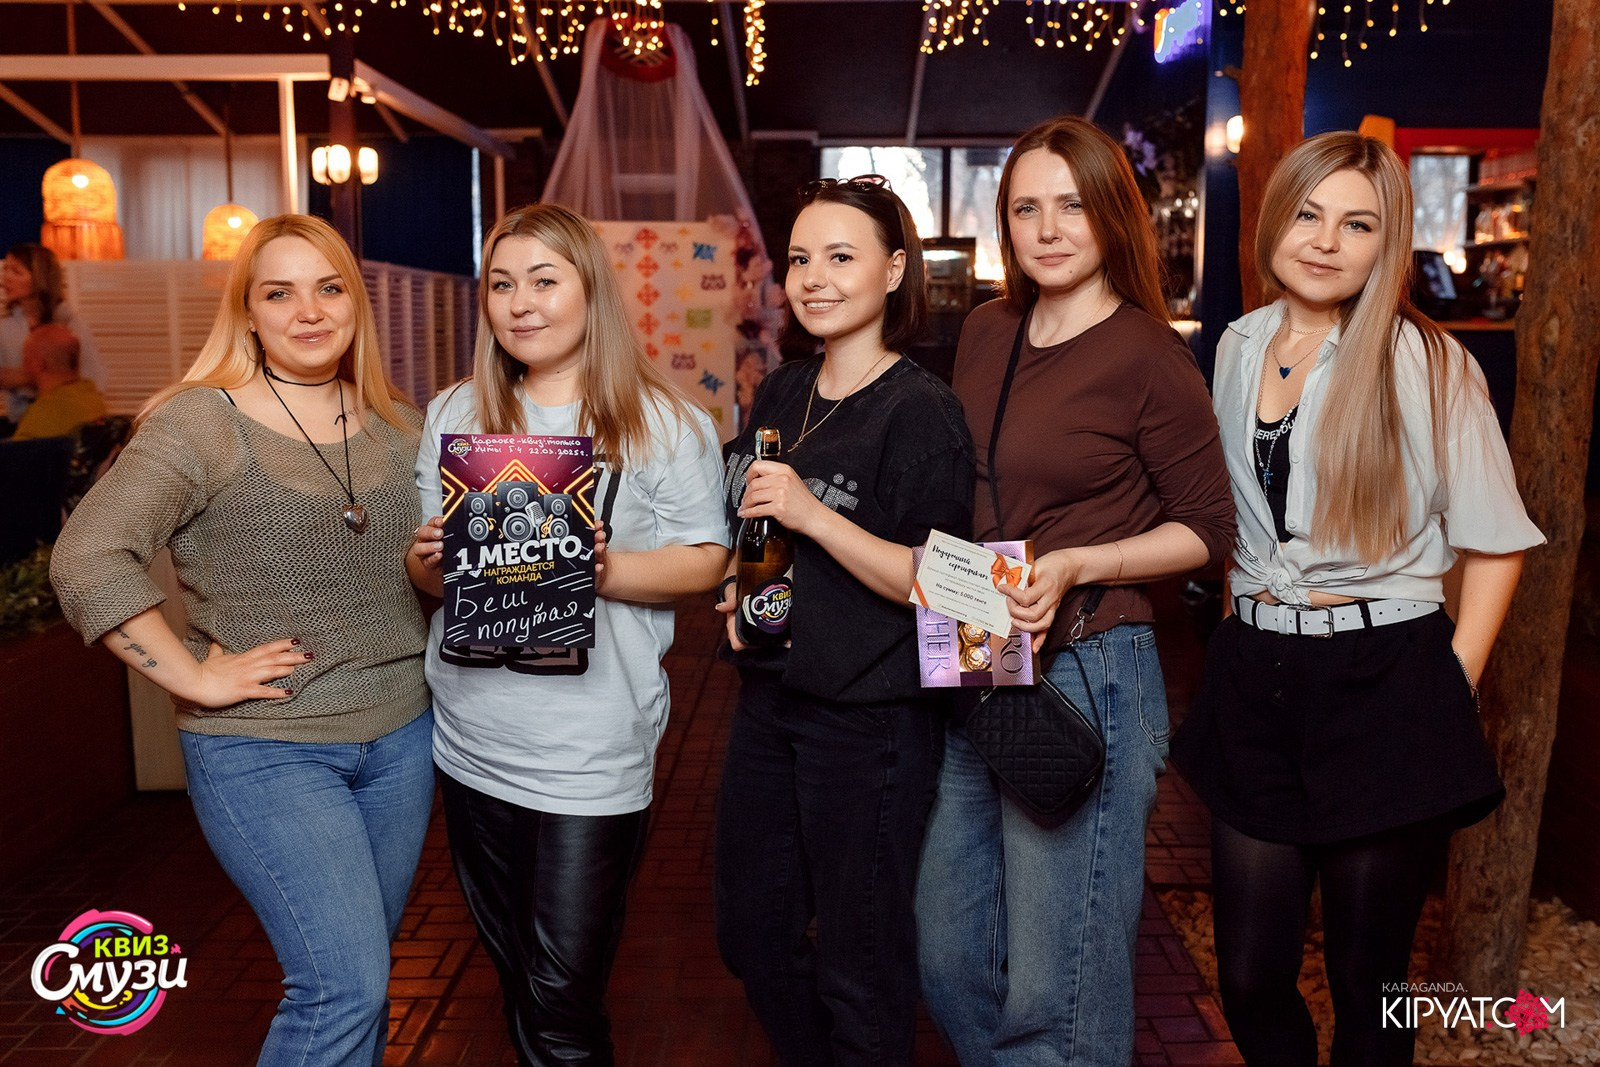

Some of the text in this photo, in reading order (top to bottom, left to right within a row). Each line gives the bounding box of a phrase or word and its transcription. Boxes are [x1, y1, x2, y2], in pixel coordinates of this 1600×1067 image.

[456, 535, 582, 571] 1 МЕСТО
[483, 561, 555, 577] НАГРАЖДАЕТСЯ
[496, 573, 543, 585] КОМАНДА
